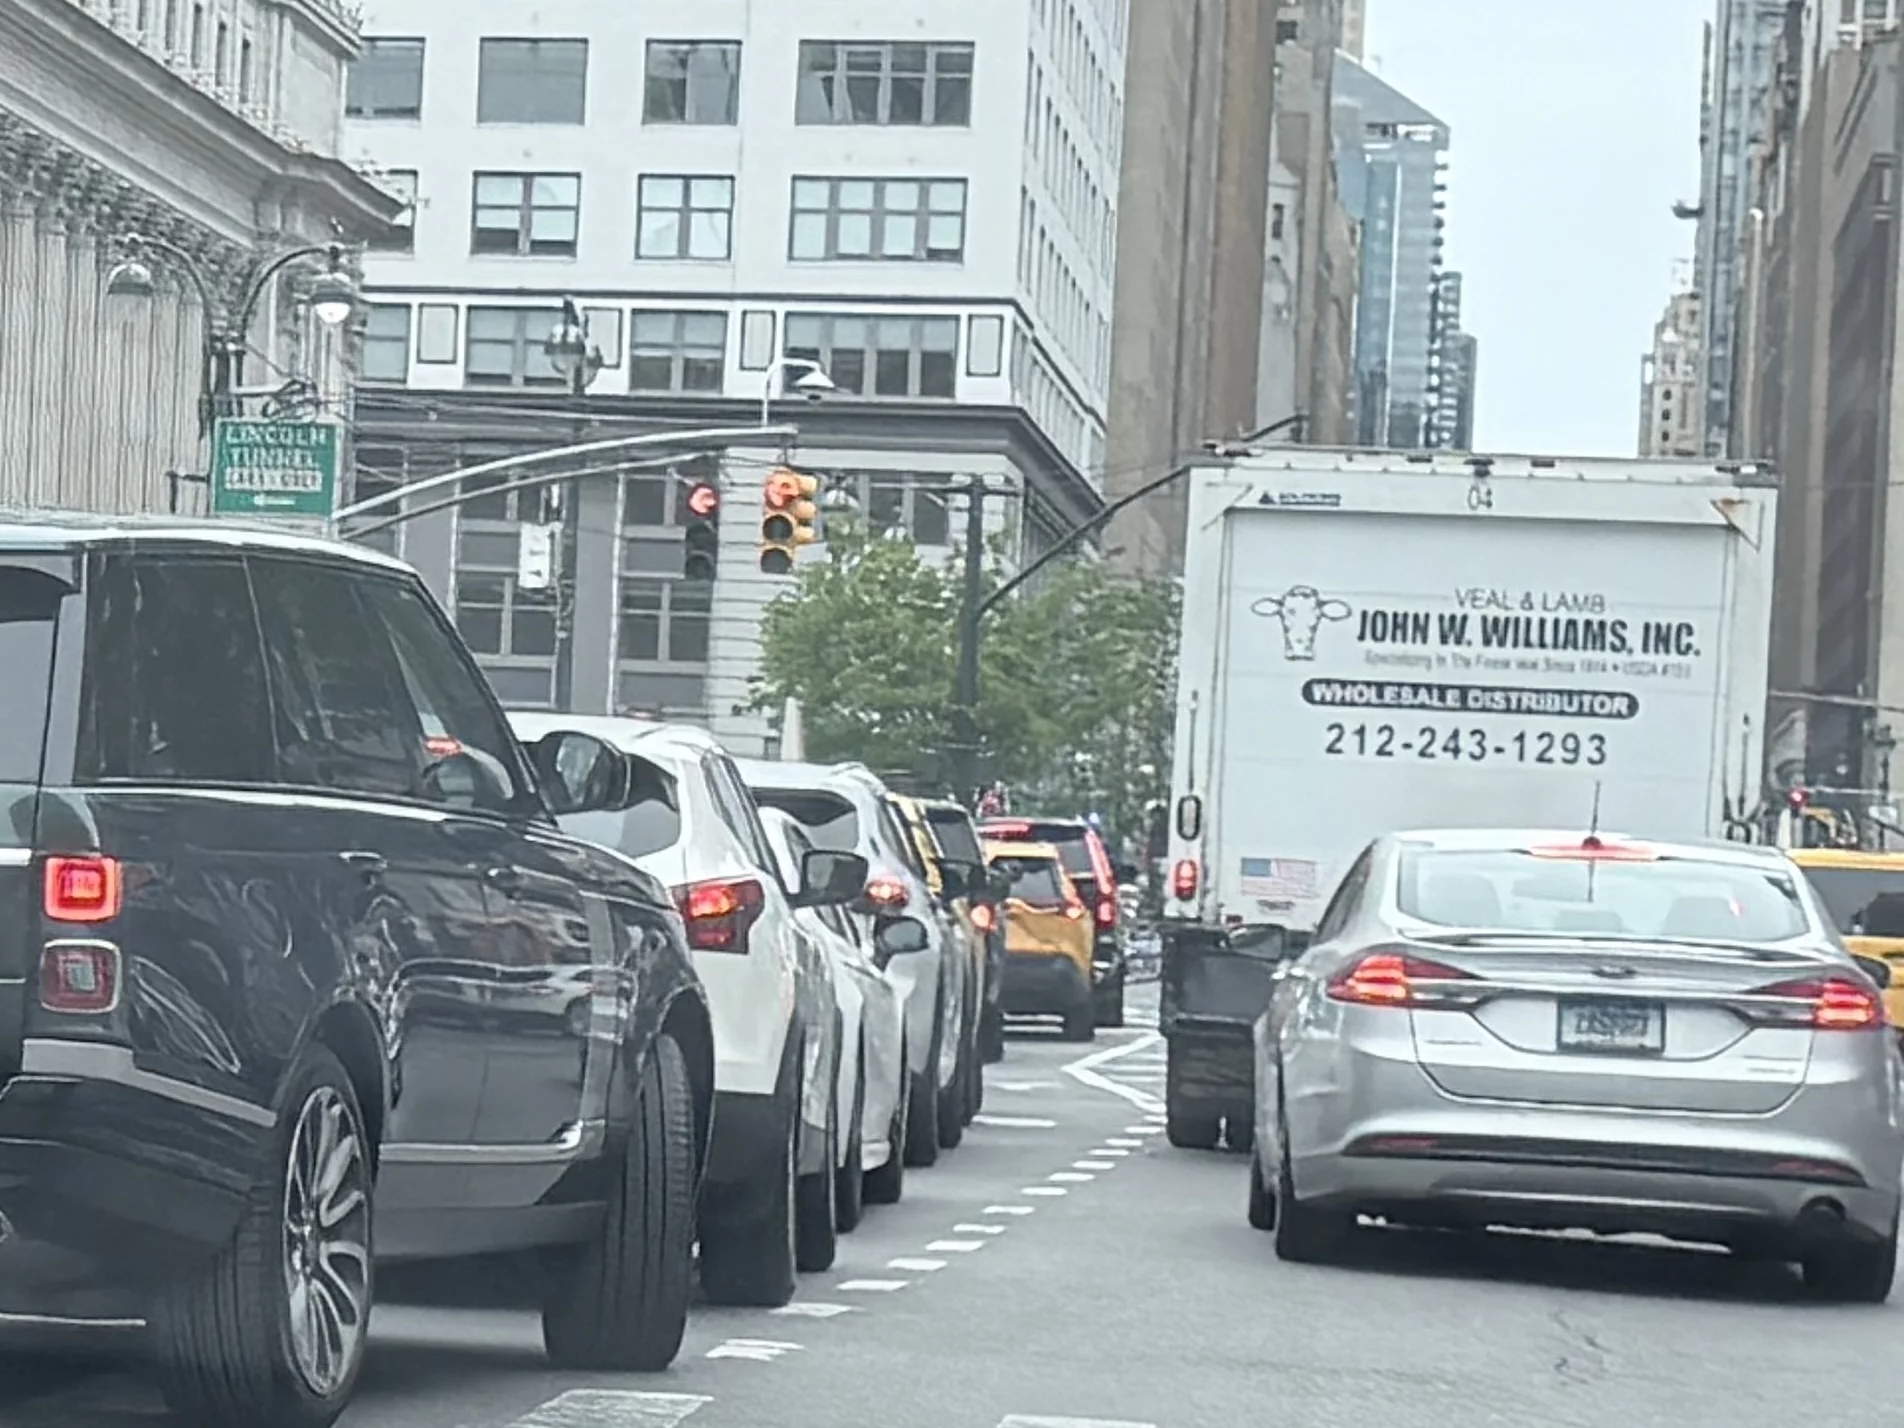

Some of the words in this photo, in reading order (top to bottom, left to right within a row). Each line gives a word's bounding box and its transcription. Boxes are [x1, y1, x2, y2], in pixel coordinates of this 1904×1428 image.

[1454, 587, 1514, 611] VEAL
[1520, 591, 1534, 612] &
[1542, 592, 1606, 614] LAMB
[1357, 609, 1430, 645] JOHN
[1438, 613, 1472, 647] W.
[1642, 621, 1702, 657] INC.
[1311, 683, 1461, 709] WHOLESALE
[1467, 688, 1630, 716] DISTRIBUTOR
[1324, 722, 1607, 766] 212-243-1293
